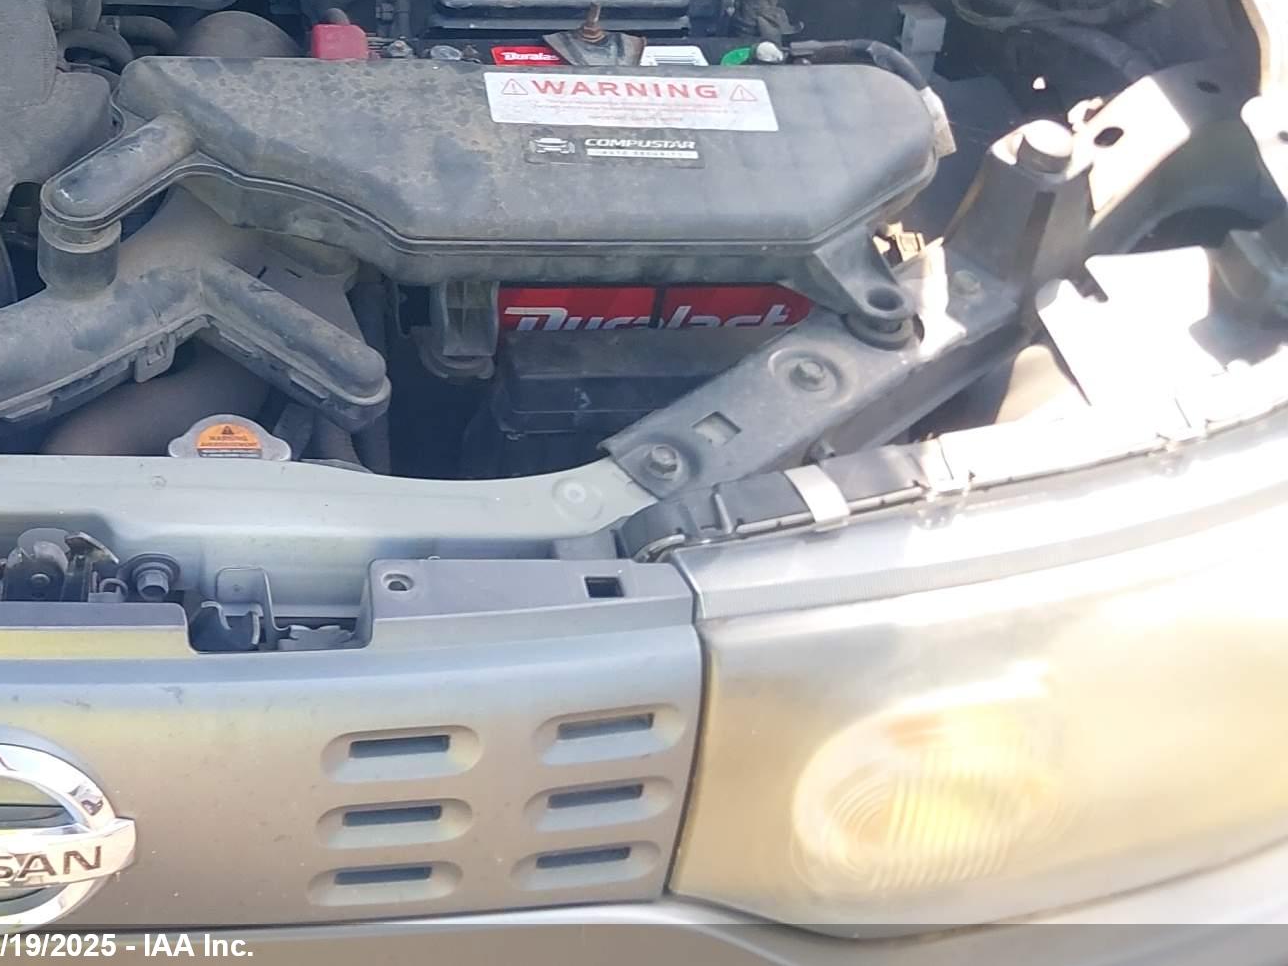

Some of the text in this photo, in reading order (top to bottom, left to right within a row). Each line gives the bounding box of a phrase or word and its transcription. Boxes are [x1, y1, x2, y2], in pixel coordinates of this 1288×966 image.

[500, 51, 560, 61] Duralas
[531, 79, 719, 99] WARNING
[584, 138, 697, 149] COMPUSTAR
